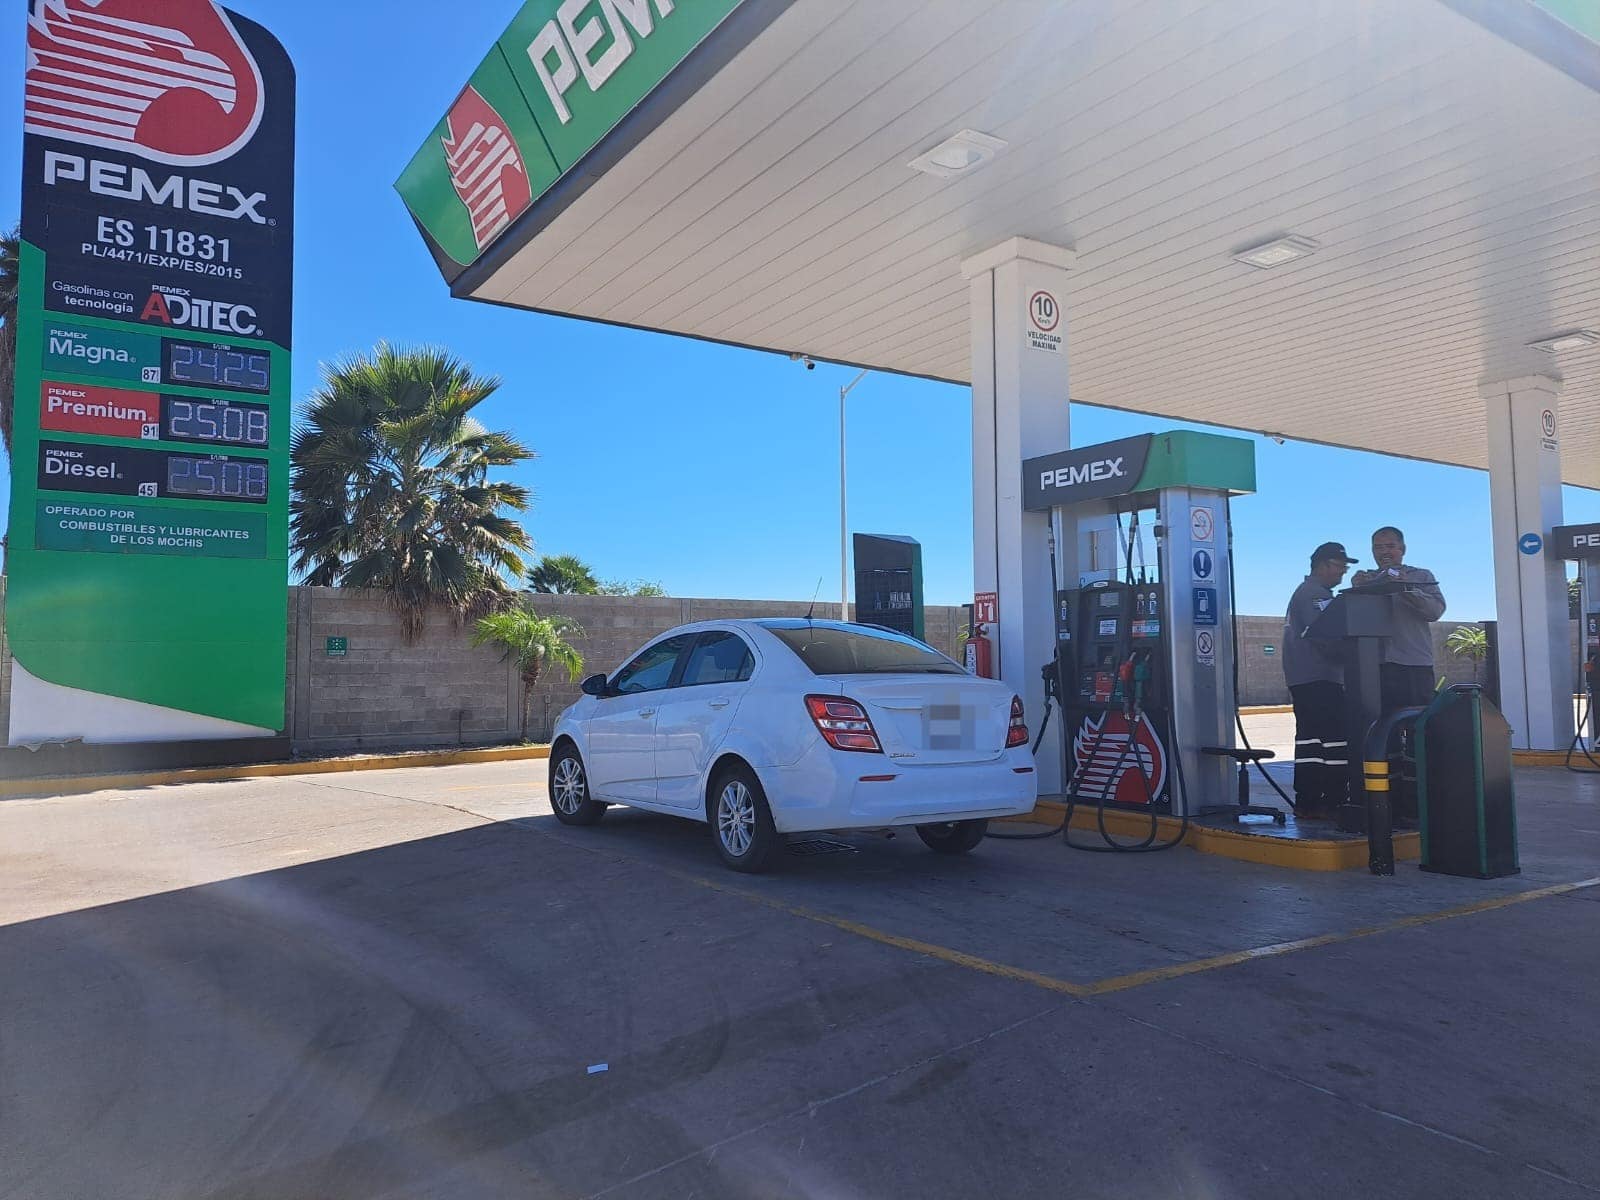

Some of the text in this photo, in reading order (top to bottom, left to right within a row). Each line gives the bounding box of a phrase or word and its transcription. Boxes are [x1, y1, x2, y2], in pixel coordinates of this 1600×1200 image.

[44, 150, 267, 225] PEMEX
[97, 215, 230, 263] ES 11831
[81, 243, 242, 279] PL/4471/EXP/ES/2015
[52, 280, 134, 301] Gasolinas con
[152, 284, 191, 297] PEMEX
[1035, 296, 1053, 317] 10
[50, 329, 88, 340] PEMEX
[1027, 330, 1062, 343] VELOCIDAD
[49, 337, 129, 364] Magna
[1032, 340, 1057, 350] MAXIMA
[143, 368, 156, 381] 87
[172, 345, 268, 388] 24.25
[48, 388, 87, 398] PEMEX
[48, 396, 147, 422] Premium
[171, 402, 268, 443] 25.08
[143, 426, 156, 438] 91
[45, 449, 84, 459] PEMEX
[45, 457, 116, 479] Diesel
[1040, 456, 1124, 491] PEMEX
[139, 484, 154, 496] 45
[45, 505, 135, 519] OPERADO POR
[59, 520, 250, 539] COMBUSTIBLES Y LUBRICANTES
[110, 534, 203, 547] DE LOS MOCHIS
[1573, 534, 1600, 547] PE
